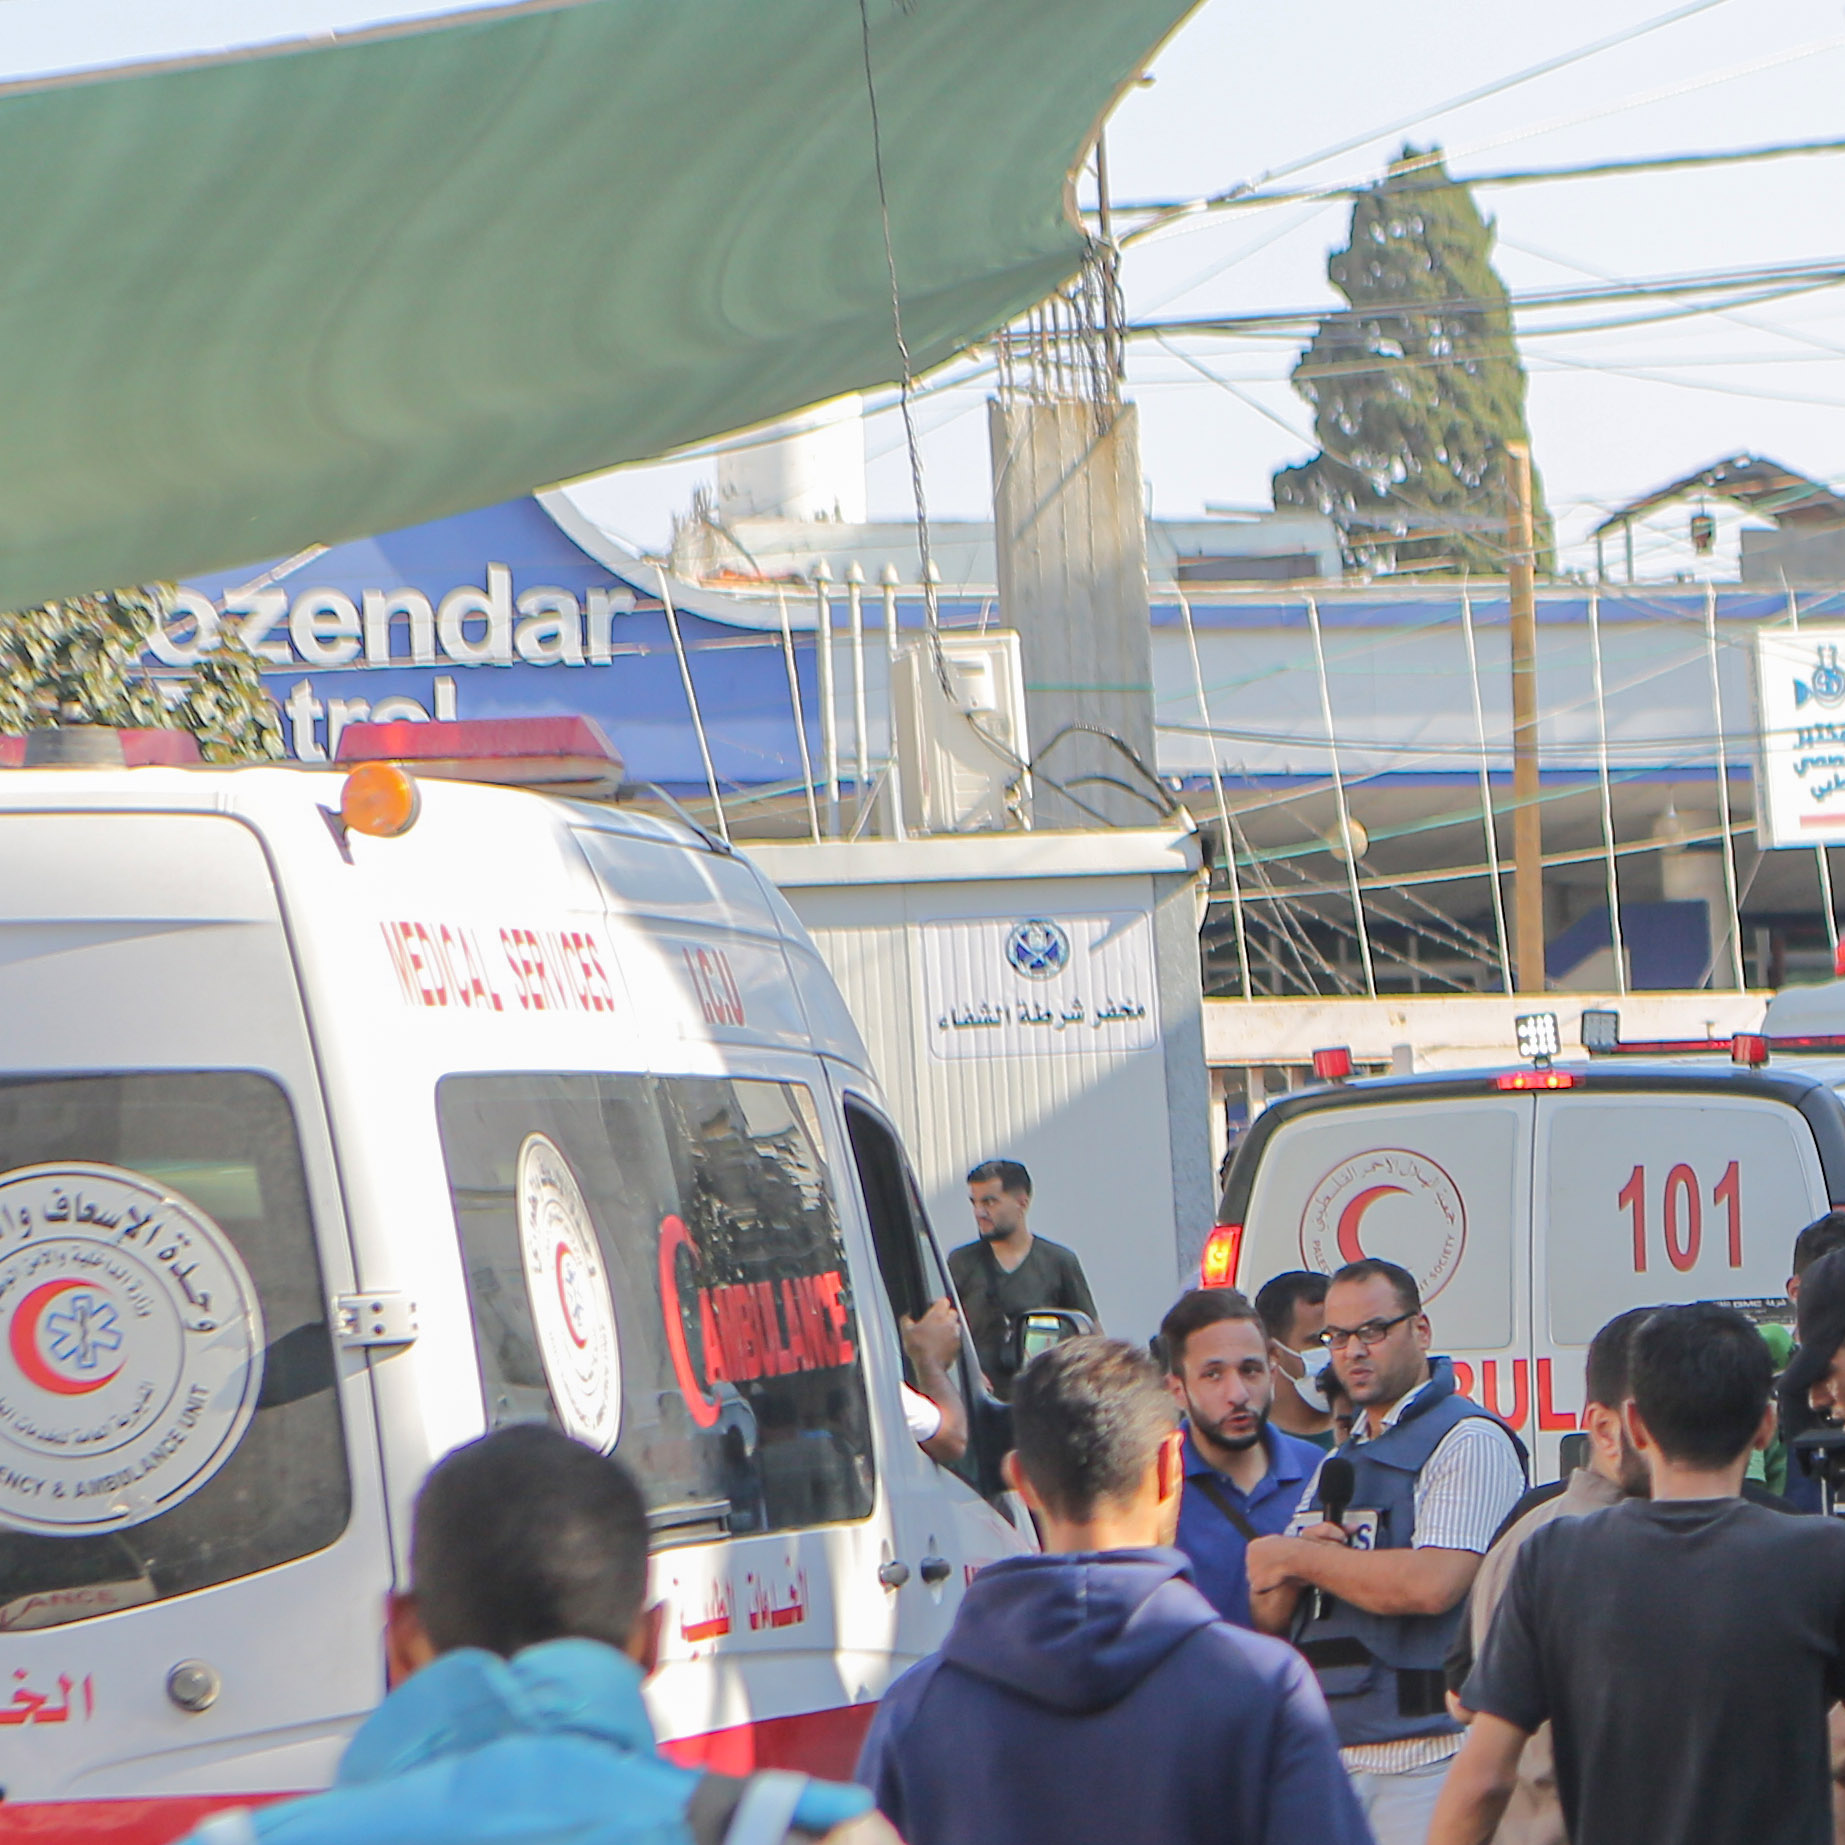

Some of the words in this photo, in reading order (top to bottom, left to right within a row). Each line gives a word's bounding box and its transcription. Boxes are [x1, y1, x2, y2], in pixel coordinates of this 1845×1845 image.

[379, 920, 504, 1012] MEDICAL
[499, 926, 615, 1012] SERVICES
[1016, 996, 1085, 1031] شرطة
[1092, 996, 1146, 1030] مخفر
[1618, 1160, 1742, 1273] 101
[698, 1270, 856, 1386] AMBULANCE
[178, 1383, 210, 1430] UNIT
